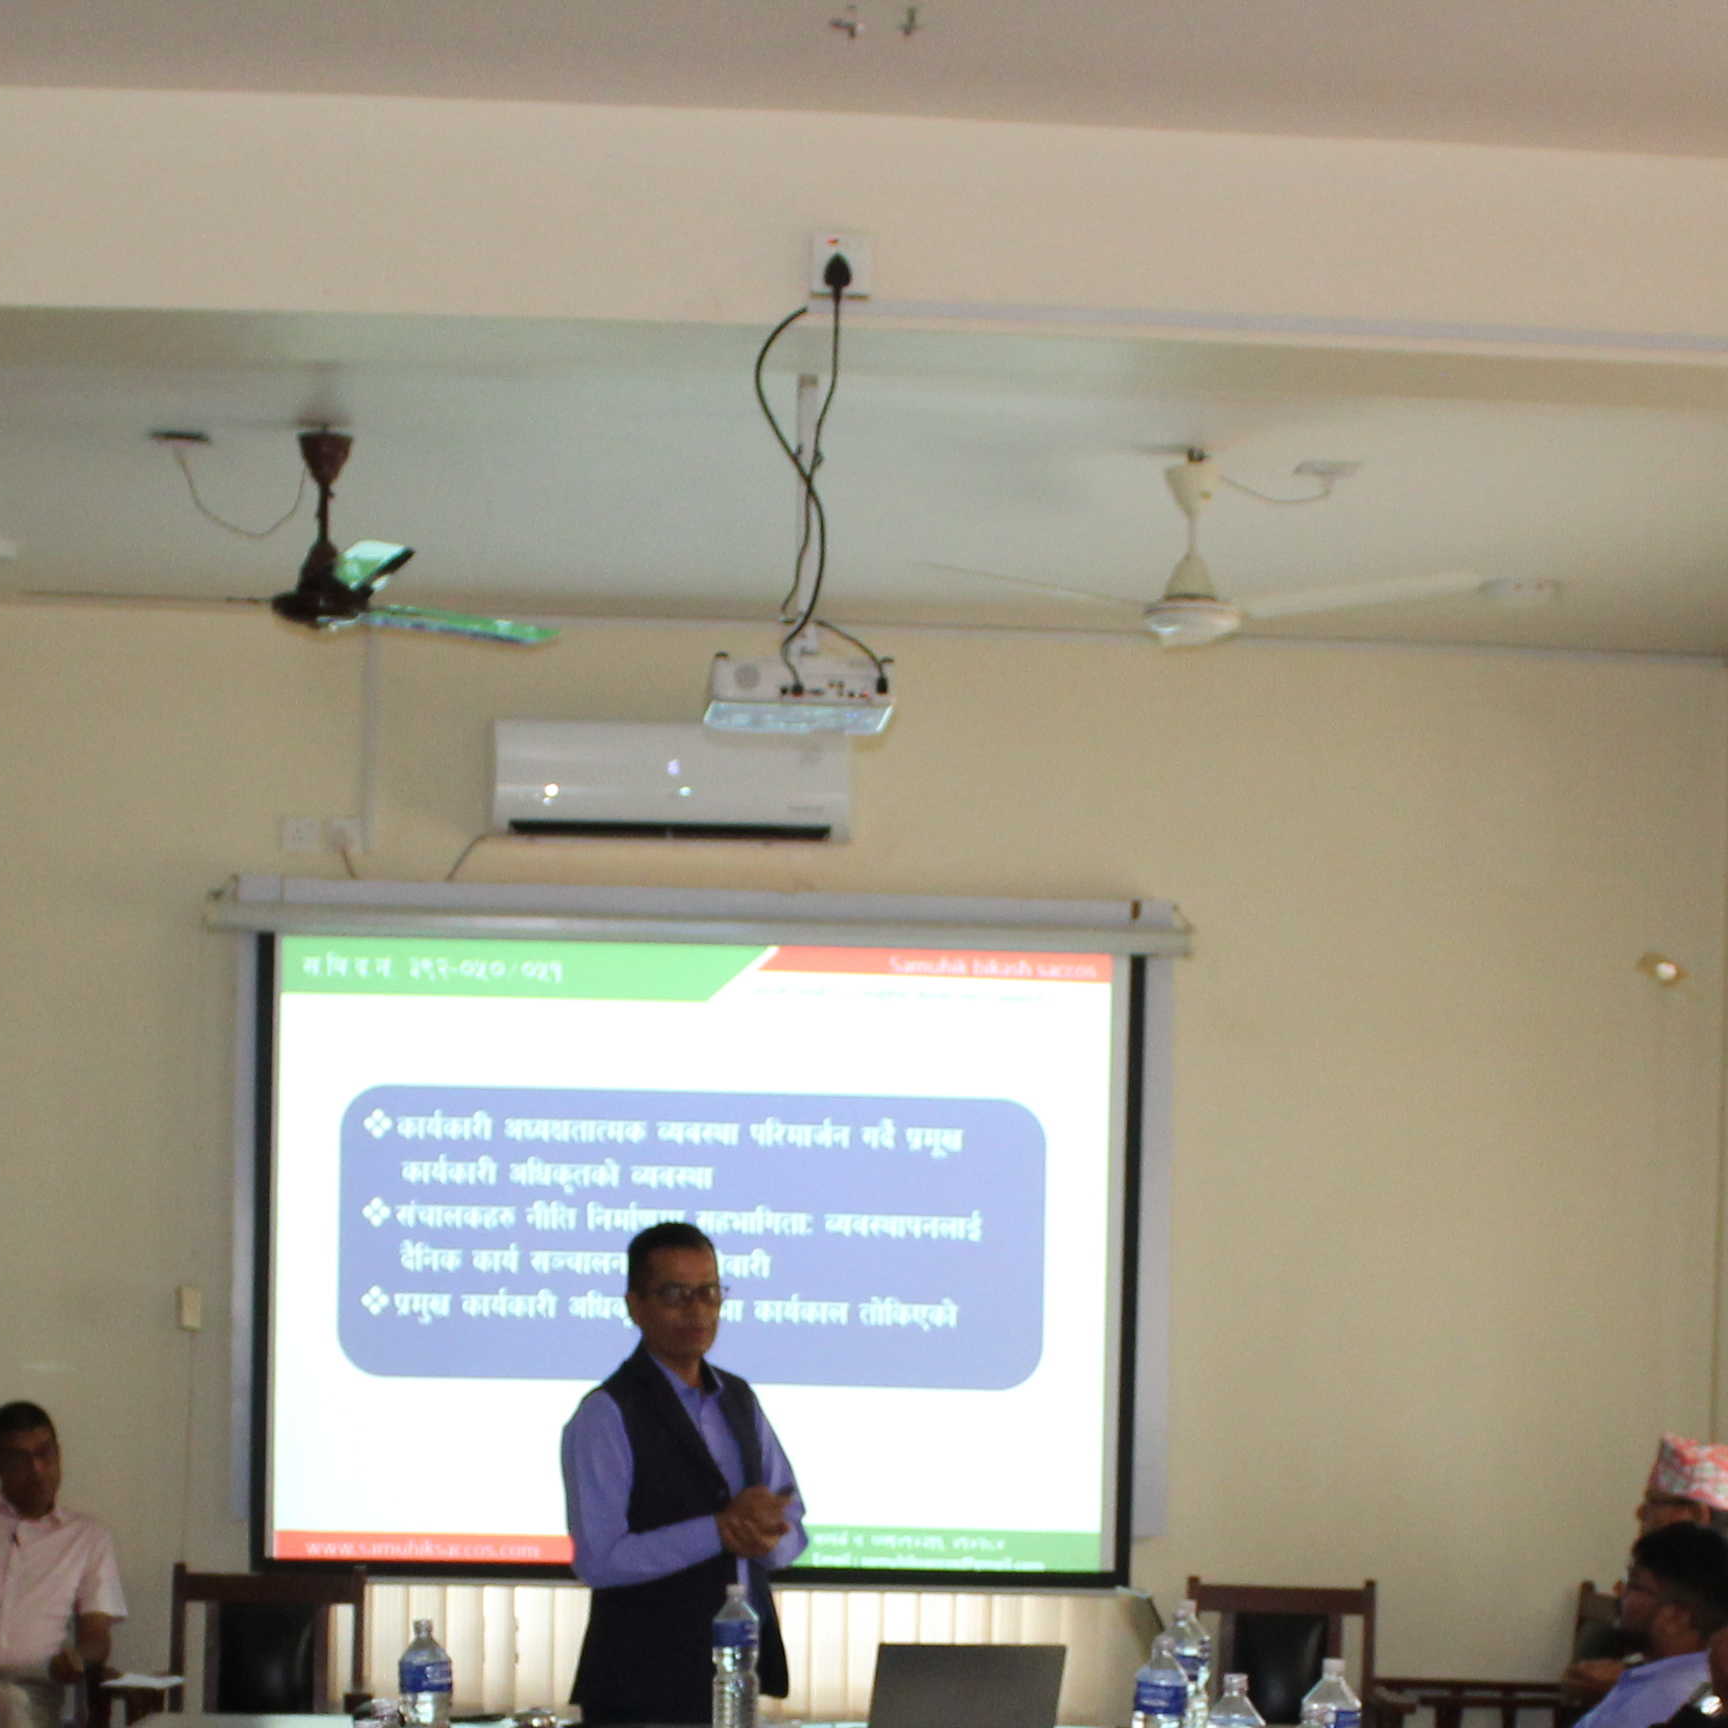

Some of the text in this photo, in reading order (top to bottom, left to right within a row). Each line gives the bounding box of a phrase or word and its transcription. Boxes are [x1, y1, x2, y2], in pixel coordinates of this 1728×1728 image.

[397, 1109, 493, 1141] कार्यकारी
[656, 1121, 740, 1147] व्यवस्था
[401, 1153, 499, 1186] कार्यकारी
[630, 1165, 715, 1190] व्यवस्था
[471, 1242, 520, 1275] कार्य
[461, 1286, 560, 1320] कार्यकारी
